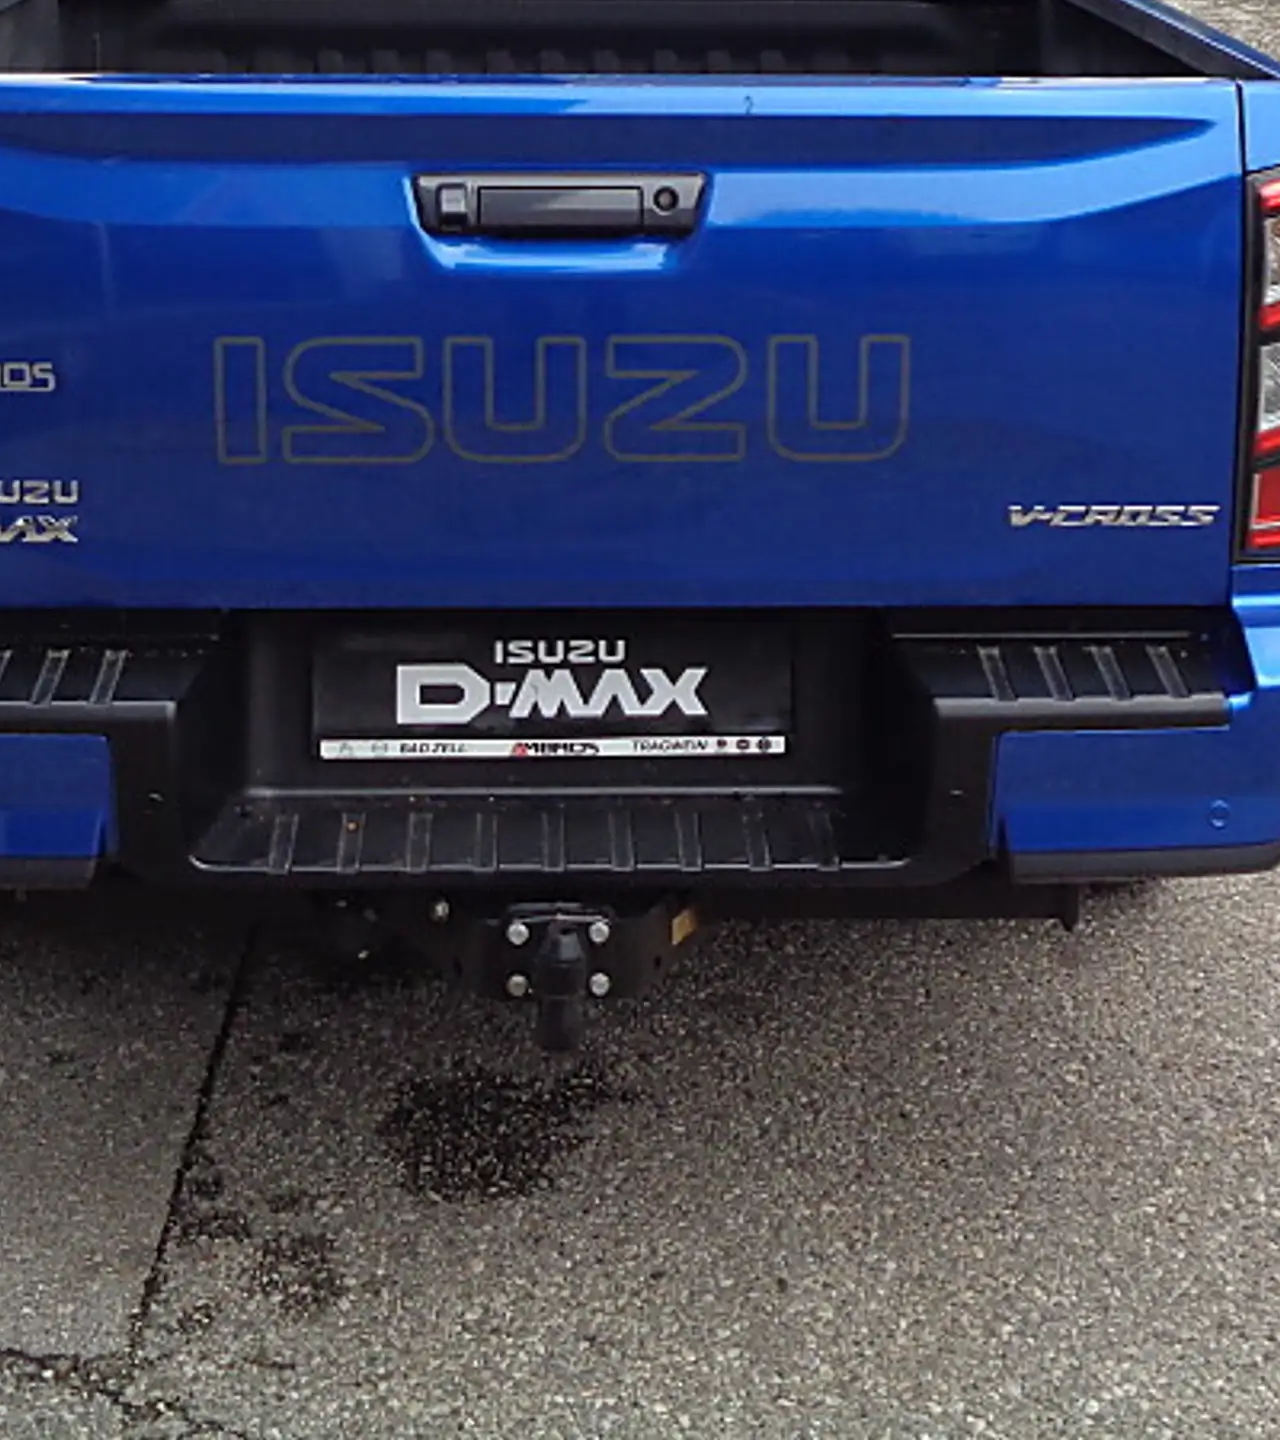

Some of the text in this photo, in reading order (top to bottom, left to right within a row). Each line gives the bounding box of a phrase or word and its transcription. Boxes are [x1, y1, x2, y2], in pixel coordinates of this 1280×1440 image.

[214, 335, 911, 462] ISUZU
[1007, 504, 1221, 528] V-CROSS
[494, 639, 627, 665] ISUZU
[395, 664, 708, 726] D-MAX
